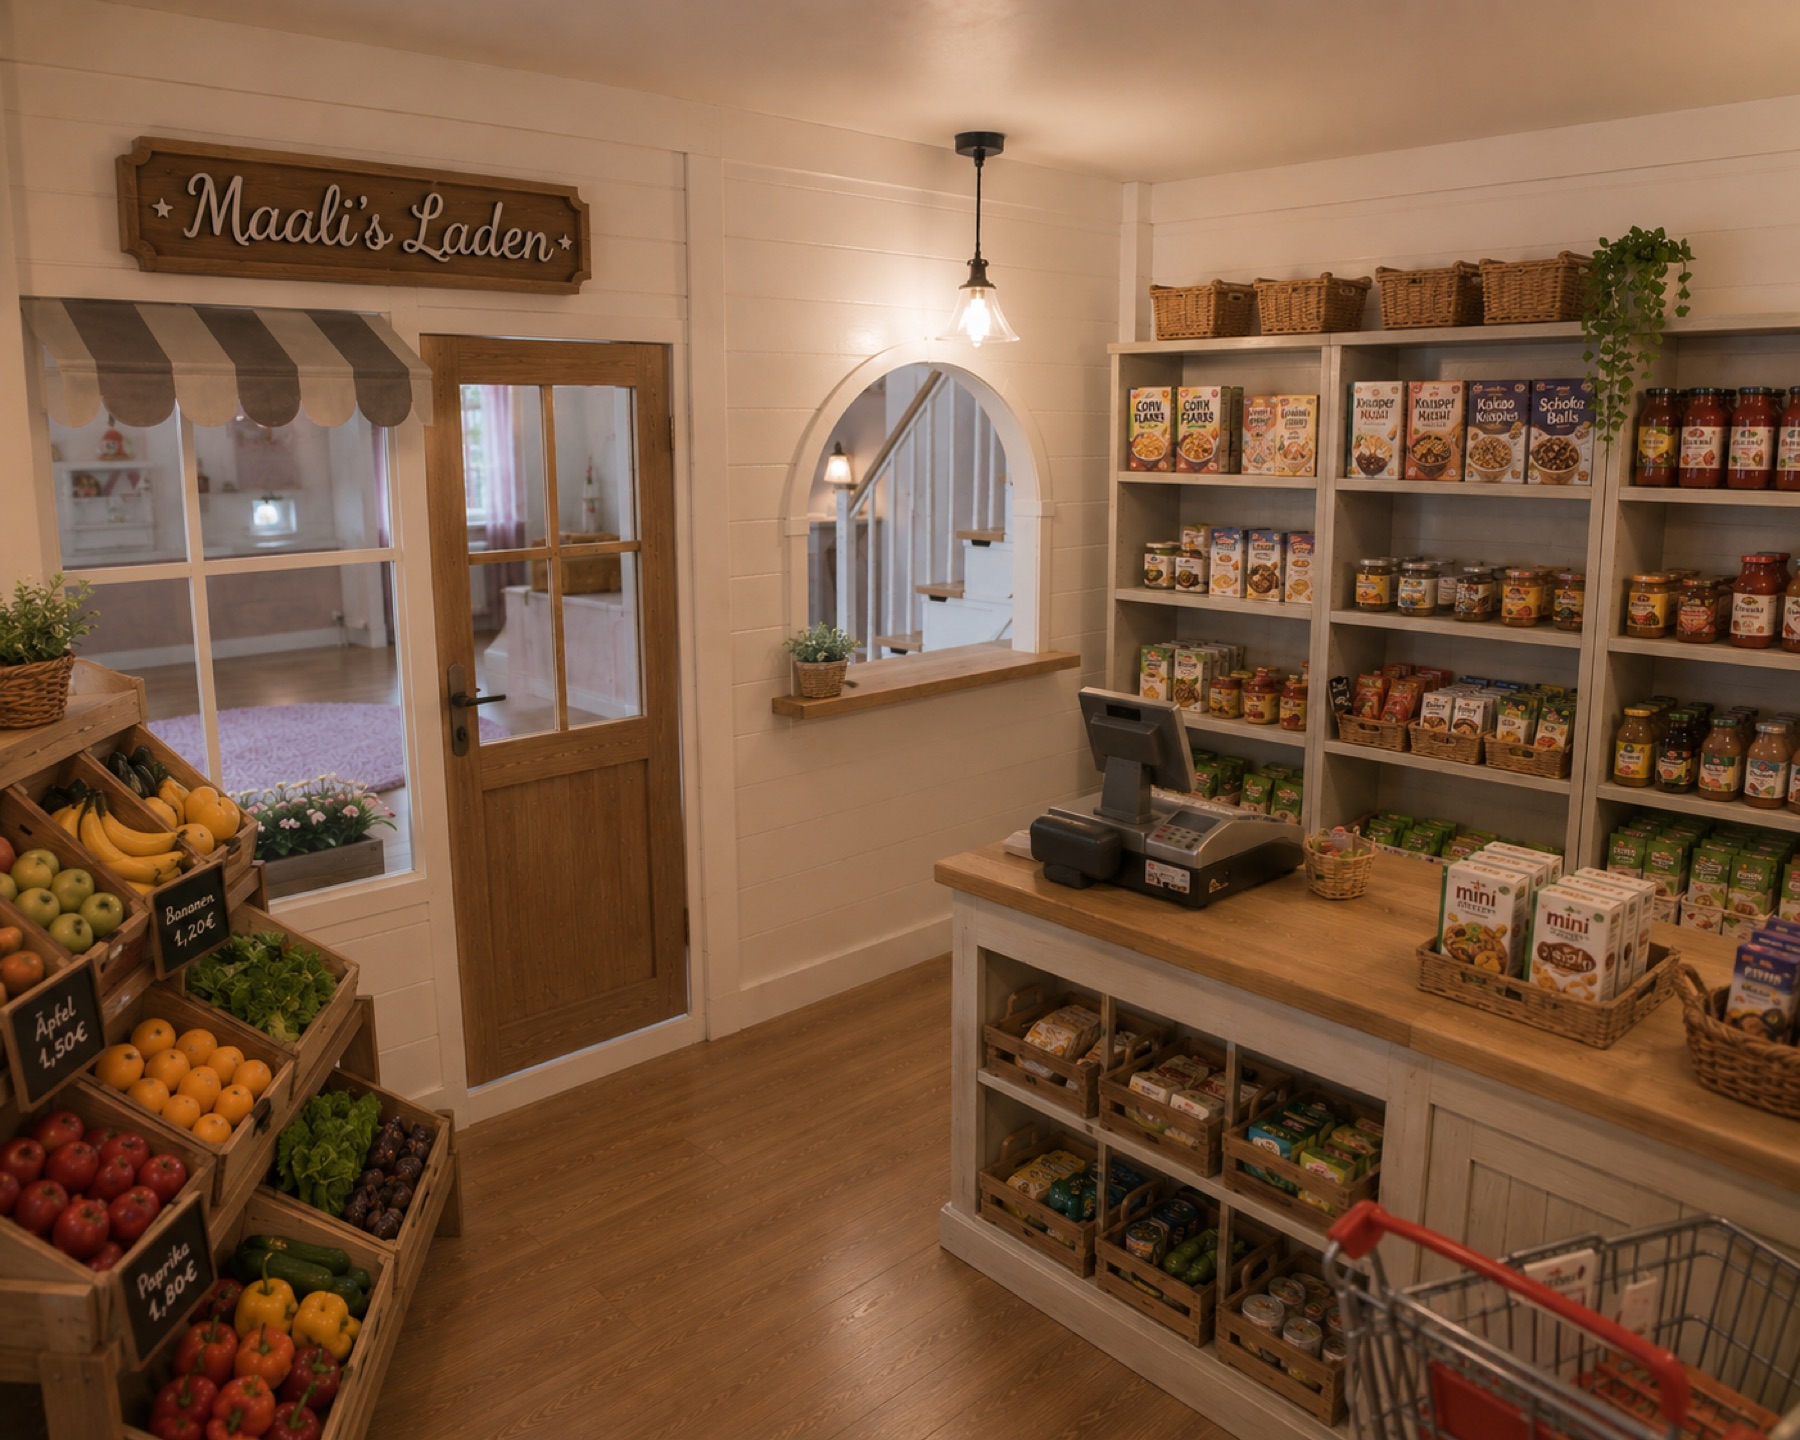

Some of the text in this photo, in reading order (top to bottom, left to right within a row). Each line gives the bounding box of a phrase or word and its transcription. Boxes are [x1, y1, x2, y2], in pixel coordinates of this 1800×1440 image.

[184, 172, 554, 263] Maali's Laden
[1547, 410, 1579, 425] Balls
[165, 894, 215, 926] Bananen
[1456, 885, 1497, 907] mini
[174, 911, 217, 947] 1,20€
[1546, 910, 1590, 934] mini
[35, 995, 77, 1042] Äpfel
[39, 1021, 88, 1069] 1,50€
[136, 1242, 190, 1300] Paprika
